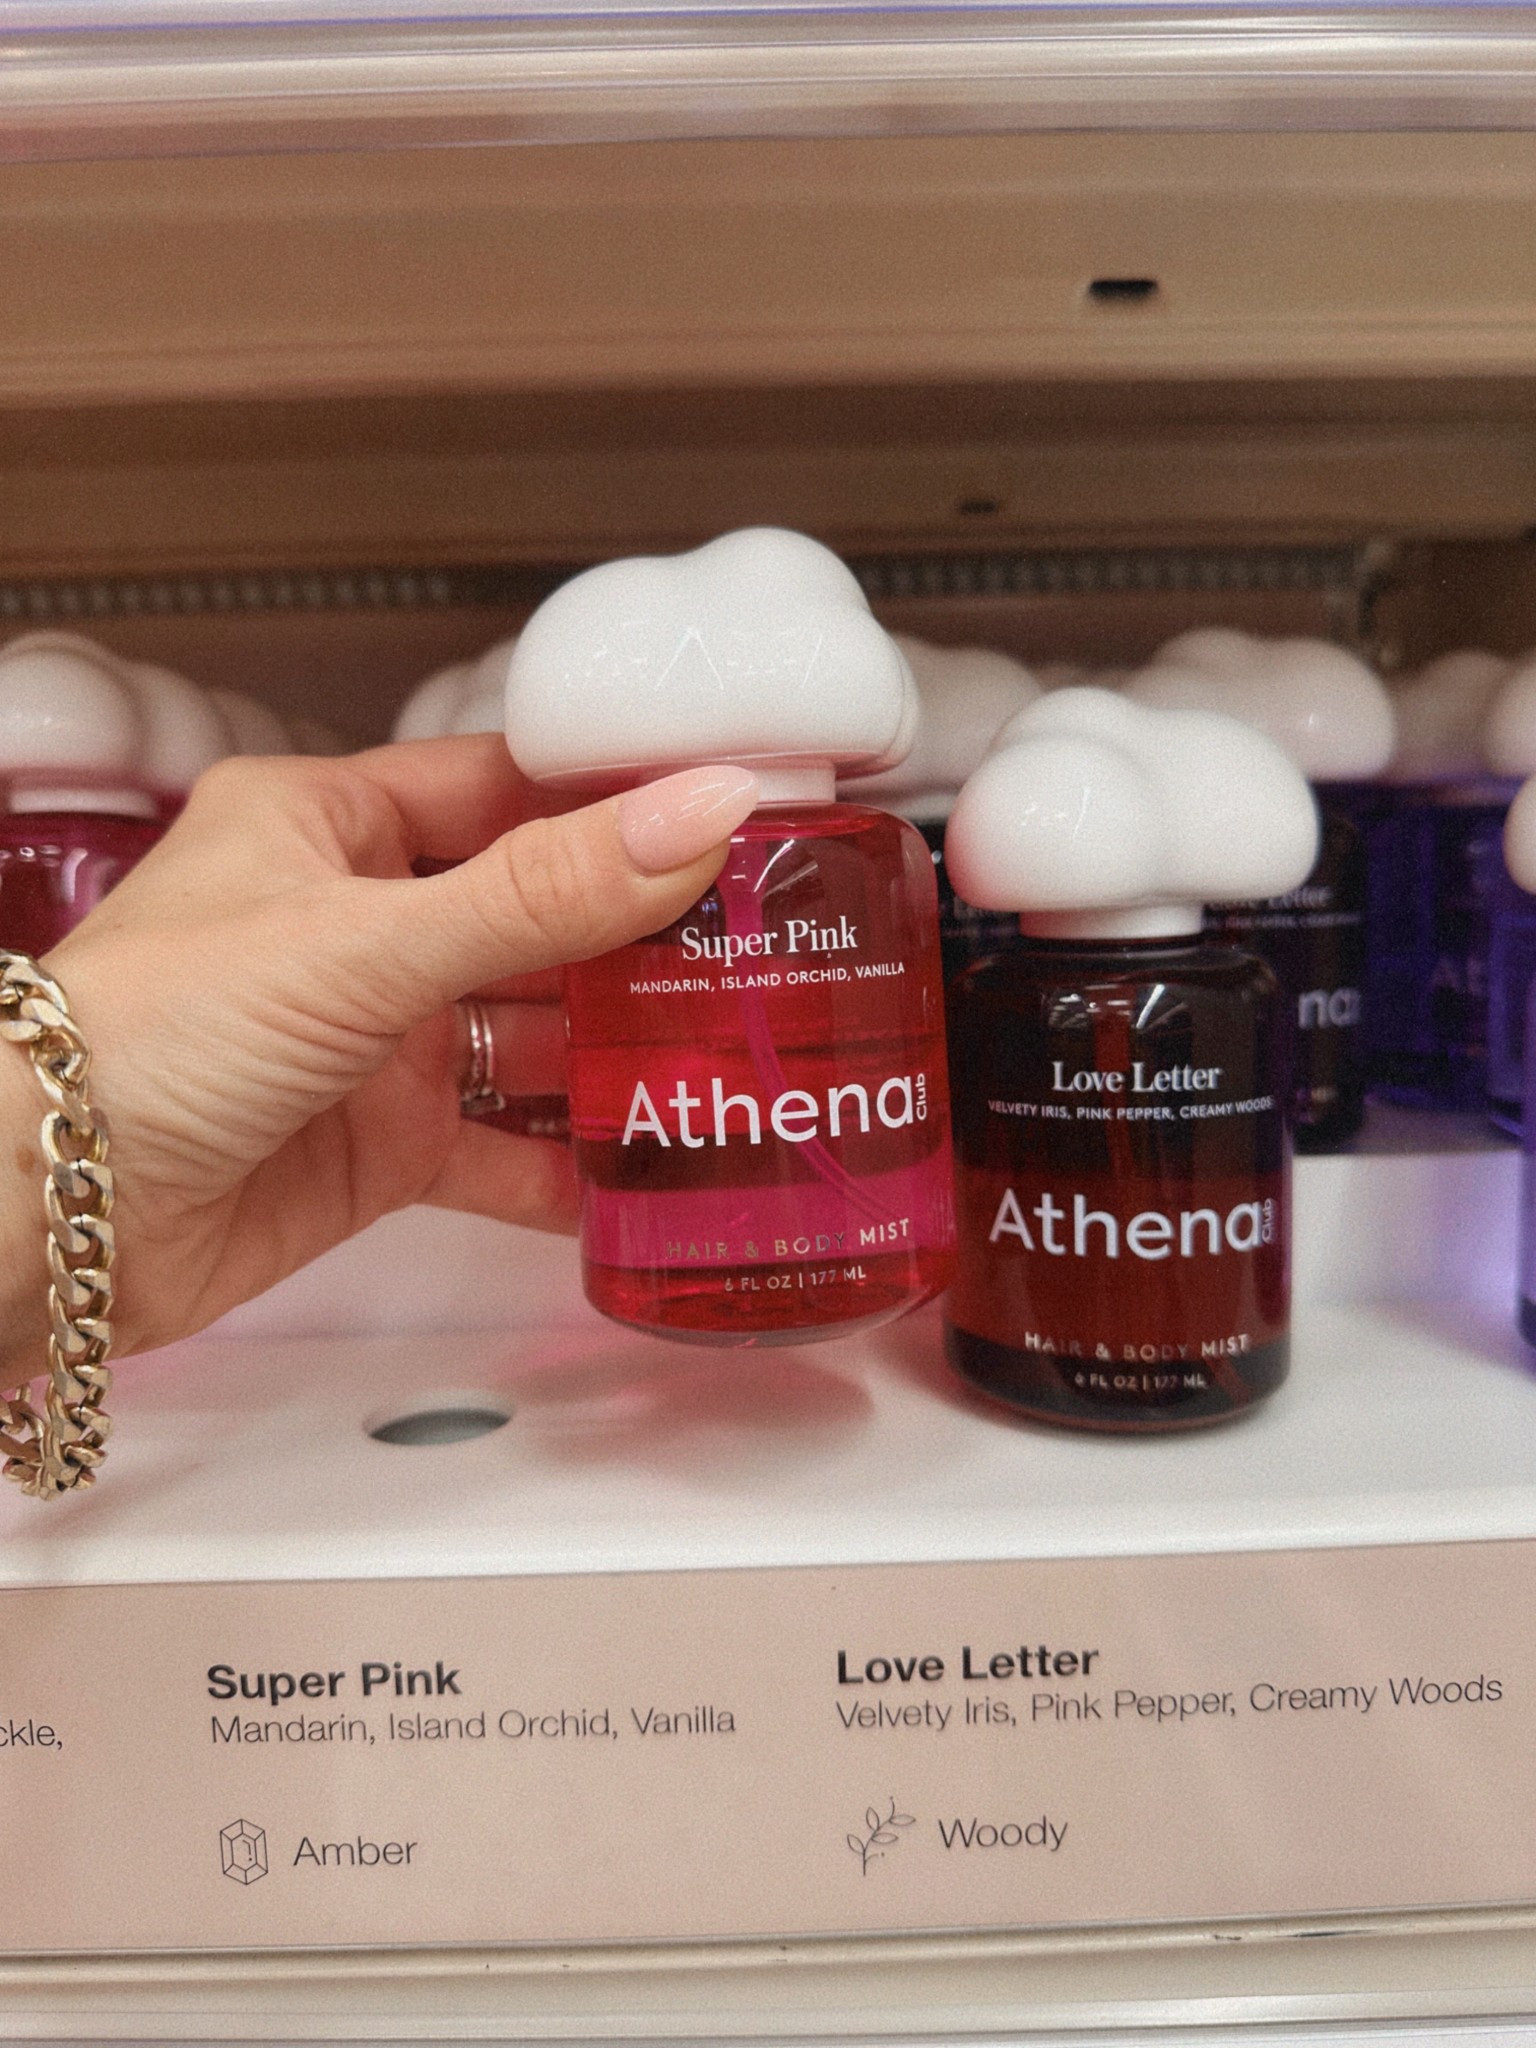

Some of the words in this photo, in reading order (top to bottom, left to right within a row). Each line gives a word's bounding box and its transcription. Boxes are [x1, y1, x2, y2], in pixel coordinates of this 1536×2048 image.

[681, 925, 778, 967] Super
[785, 915, 858, 954] Pink
[630, 977, 716, 994] MANDARIN,
[721, 973, 781, 990] ISLAND
[786, 967, 852, 986] ORCHID,
[855, 962, 905, 979] VANILLA
[1052, 1061, 1124, 1093] Love
[1132, 1061, 1222, 1092] Letter
[621, 1075, 914, 1148] Athena
[915, 1073, 928, 1121] Club
[988, 1100, 1038, 1117] VELVETY
[1041, 1103, 1071, 1120] IRIS,
[1076, 1106, 1112, 1121] PINK
[1117, 1106, 1175, 1121] PEPPER,
[1180, 1102, 1235, 1119] CREAMY
[1235, 1096, 1275, 1115] WOODS
[666, 1241, 729, 1260] HAIR
[745, 1239, 759, 1258] &
[775, 1233, 846, 1256] BODY
[860, 1218, 911, 1246] MIST
[989, 1187, 1261, 1260] Athena
[1261, 1198, 1273, 1243] Club
[741, 1275, 760, 1291] FL
[767, 1273, 792, 1290] OZ
[811, 1269, 837, 1286] 177
[844, 1266, 867, 1282] ML
[1025, 1332, 1081, 1358] HAIR
[1201, 1333, 1250, 1356] MIST
[207, 1664, 345, 1704] Super
[361, 1661, 461, 1696] Pink
[838, 1649, 945, 1684] Love
[962, 1645, 1099, 1679] Letter
[836, 1701, 951, 1730] Velvety
[965, 1697, 1017, 1726] Iris,
[1032, 1694, 1100, 1721] Pink
[1113, 1688, 1236, 1722] Pepper,
[1249, 1680, 1378, 1714] Creamy
[1389, 1674, 1503, 1705] Woods
[211, 1714, 376, 1744] Mandarin,
[389, 1713, 486, 1740] Island
[499, 1708, 618, 1739] Orchid,
[630, 1706, 736, 1735] Vanilla
[293, 1836, 418, 1865] Amber
[938, 1815, 1068, 1851] Woody
